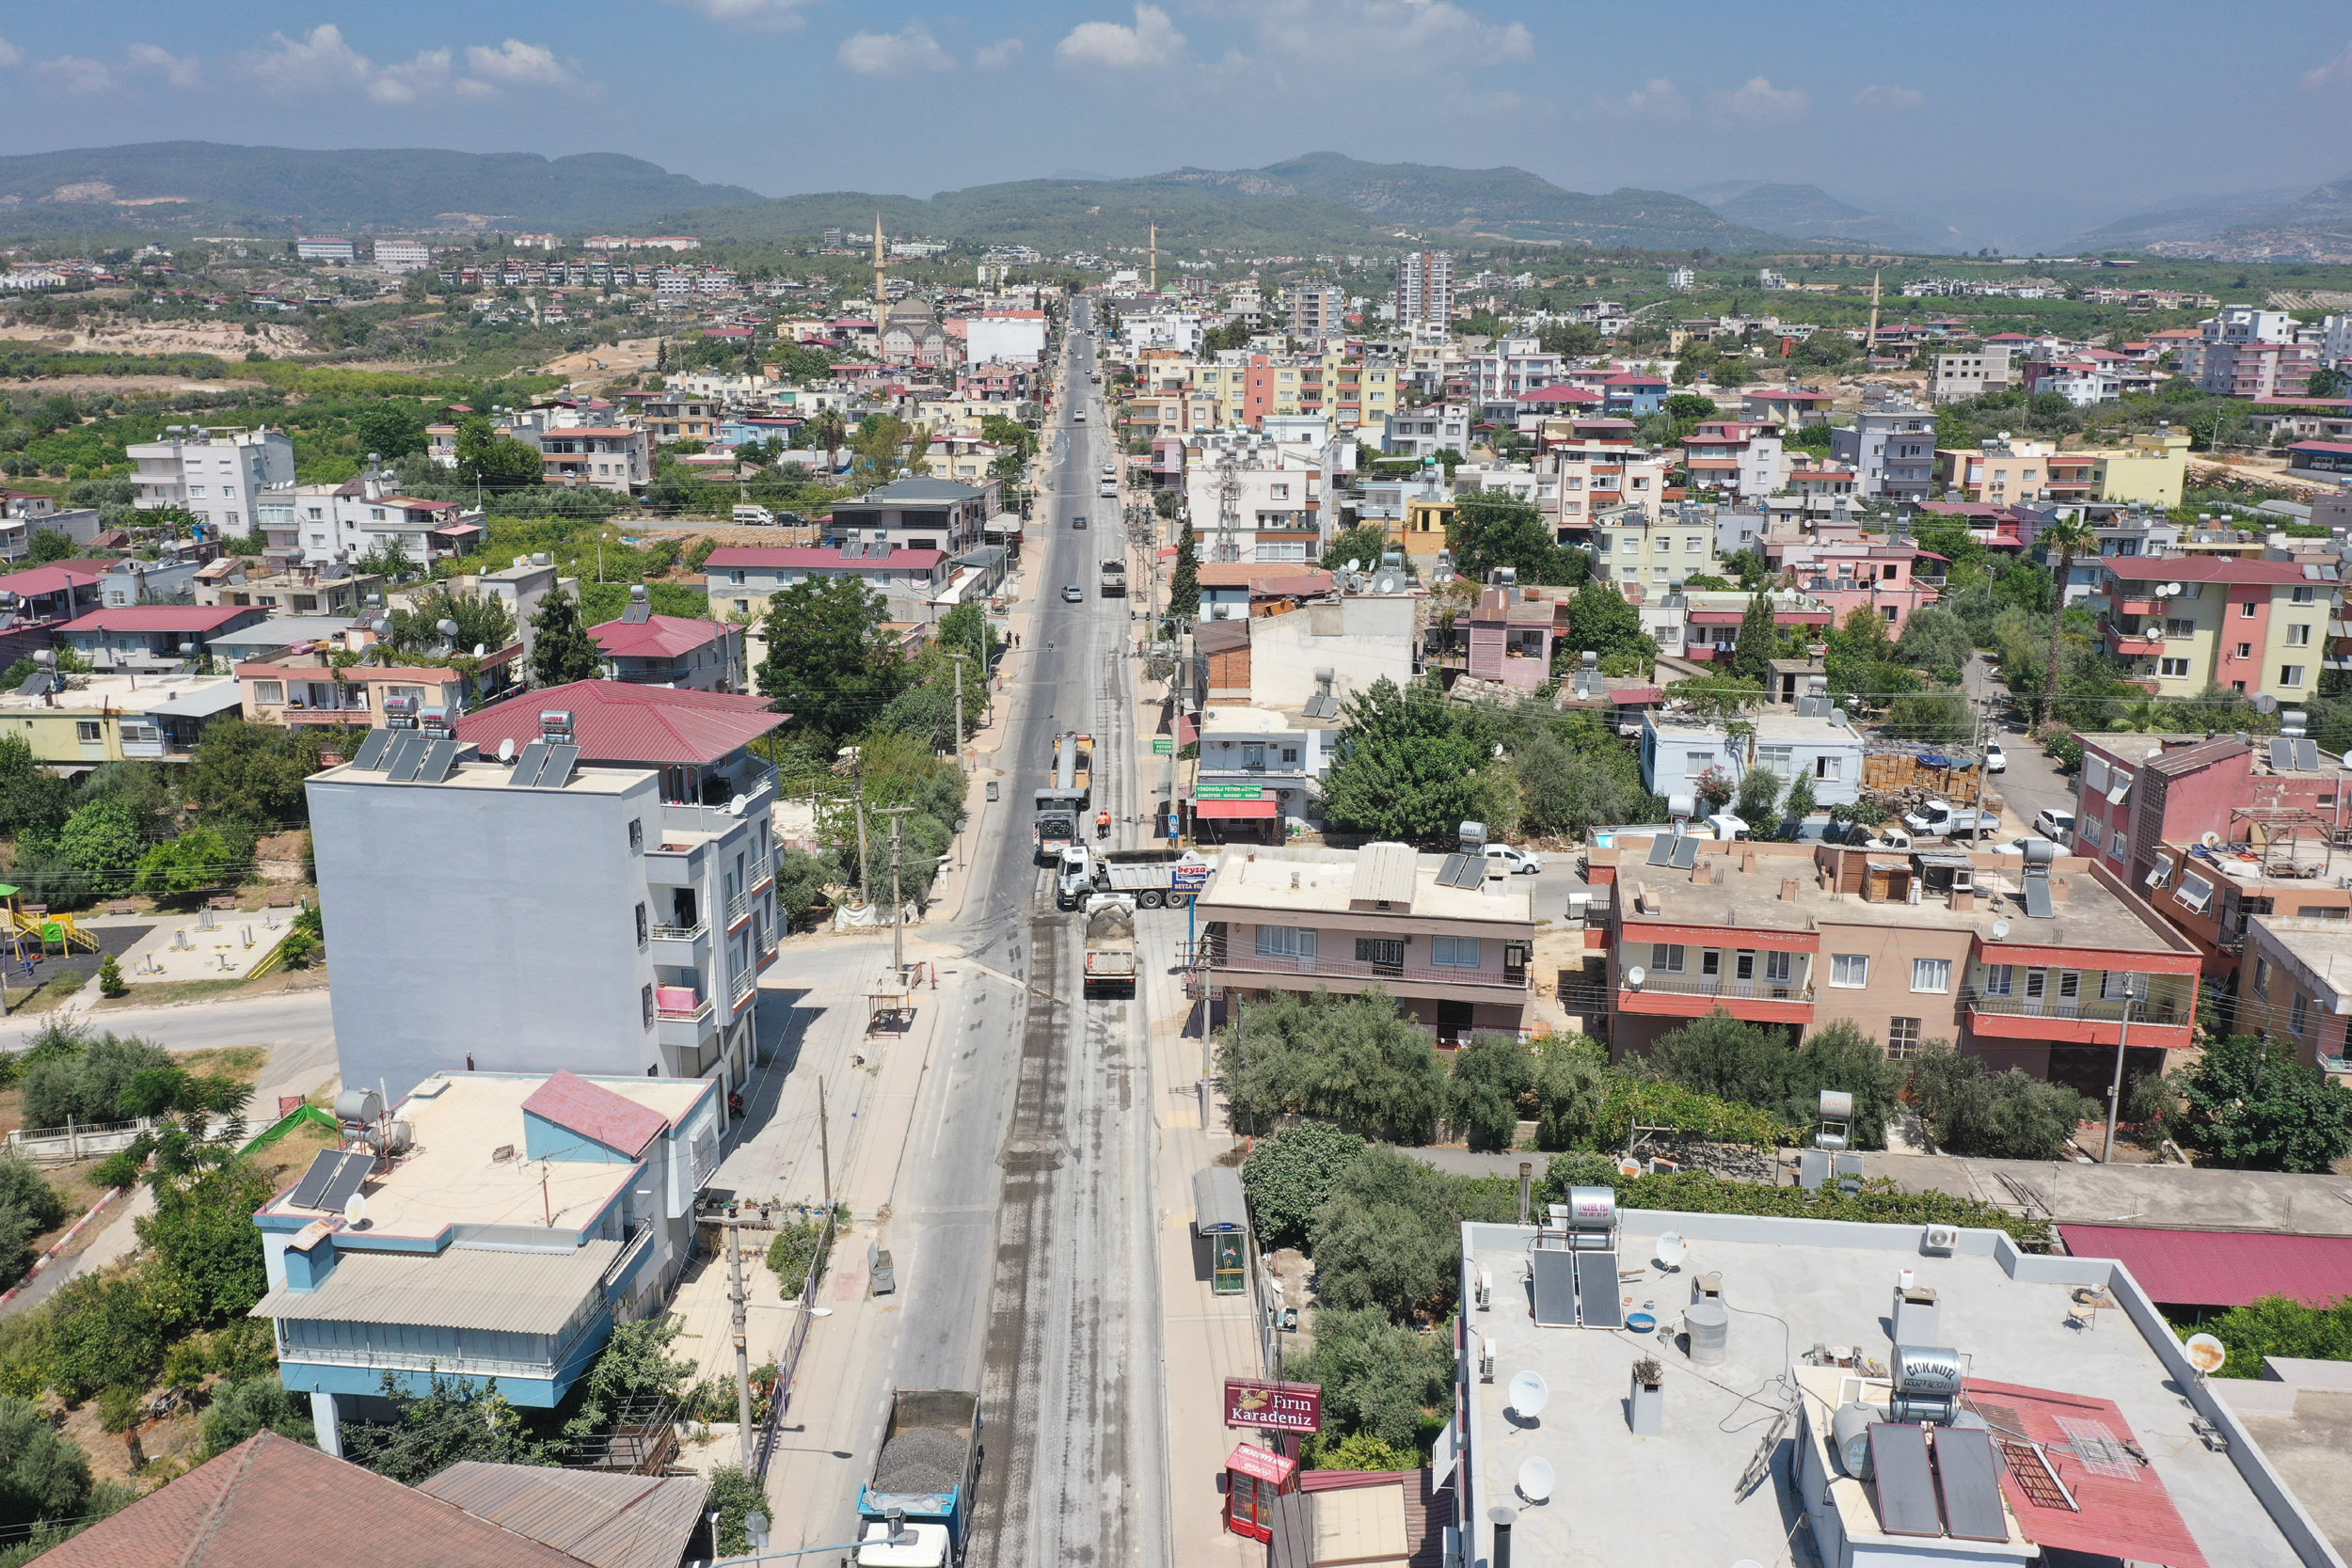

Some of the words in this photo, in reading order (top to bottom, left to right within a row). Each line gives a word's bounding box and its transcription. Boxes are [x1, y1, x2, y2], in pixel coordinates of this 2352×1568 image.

[1177, 865, 1206, 875] beyza
[1273, 1394, 1312, 1411] Fırın
[1232, 1407, 1312, 1426] Karadeniz
